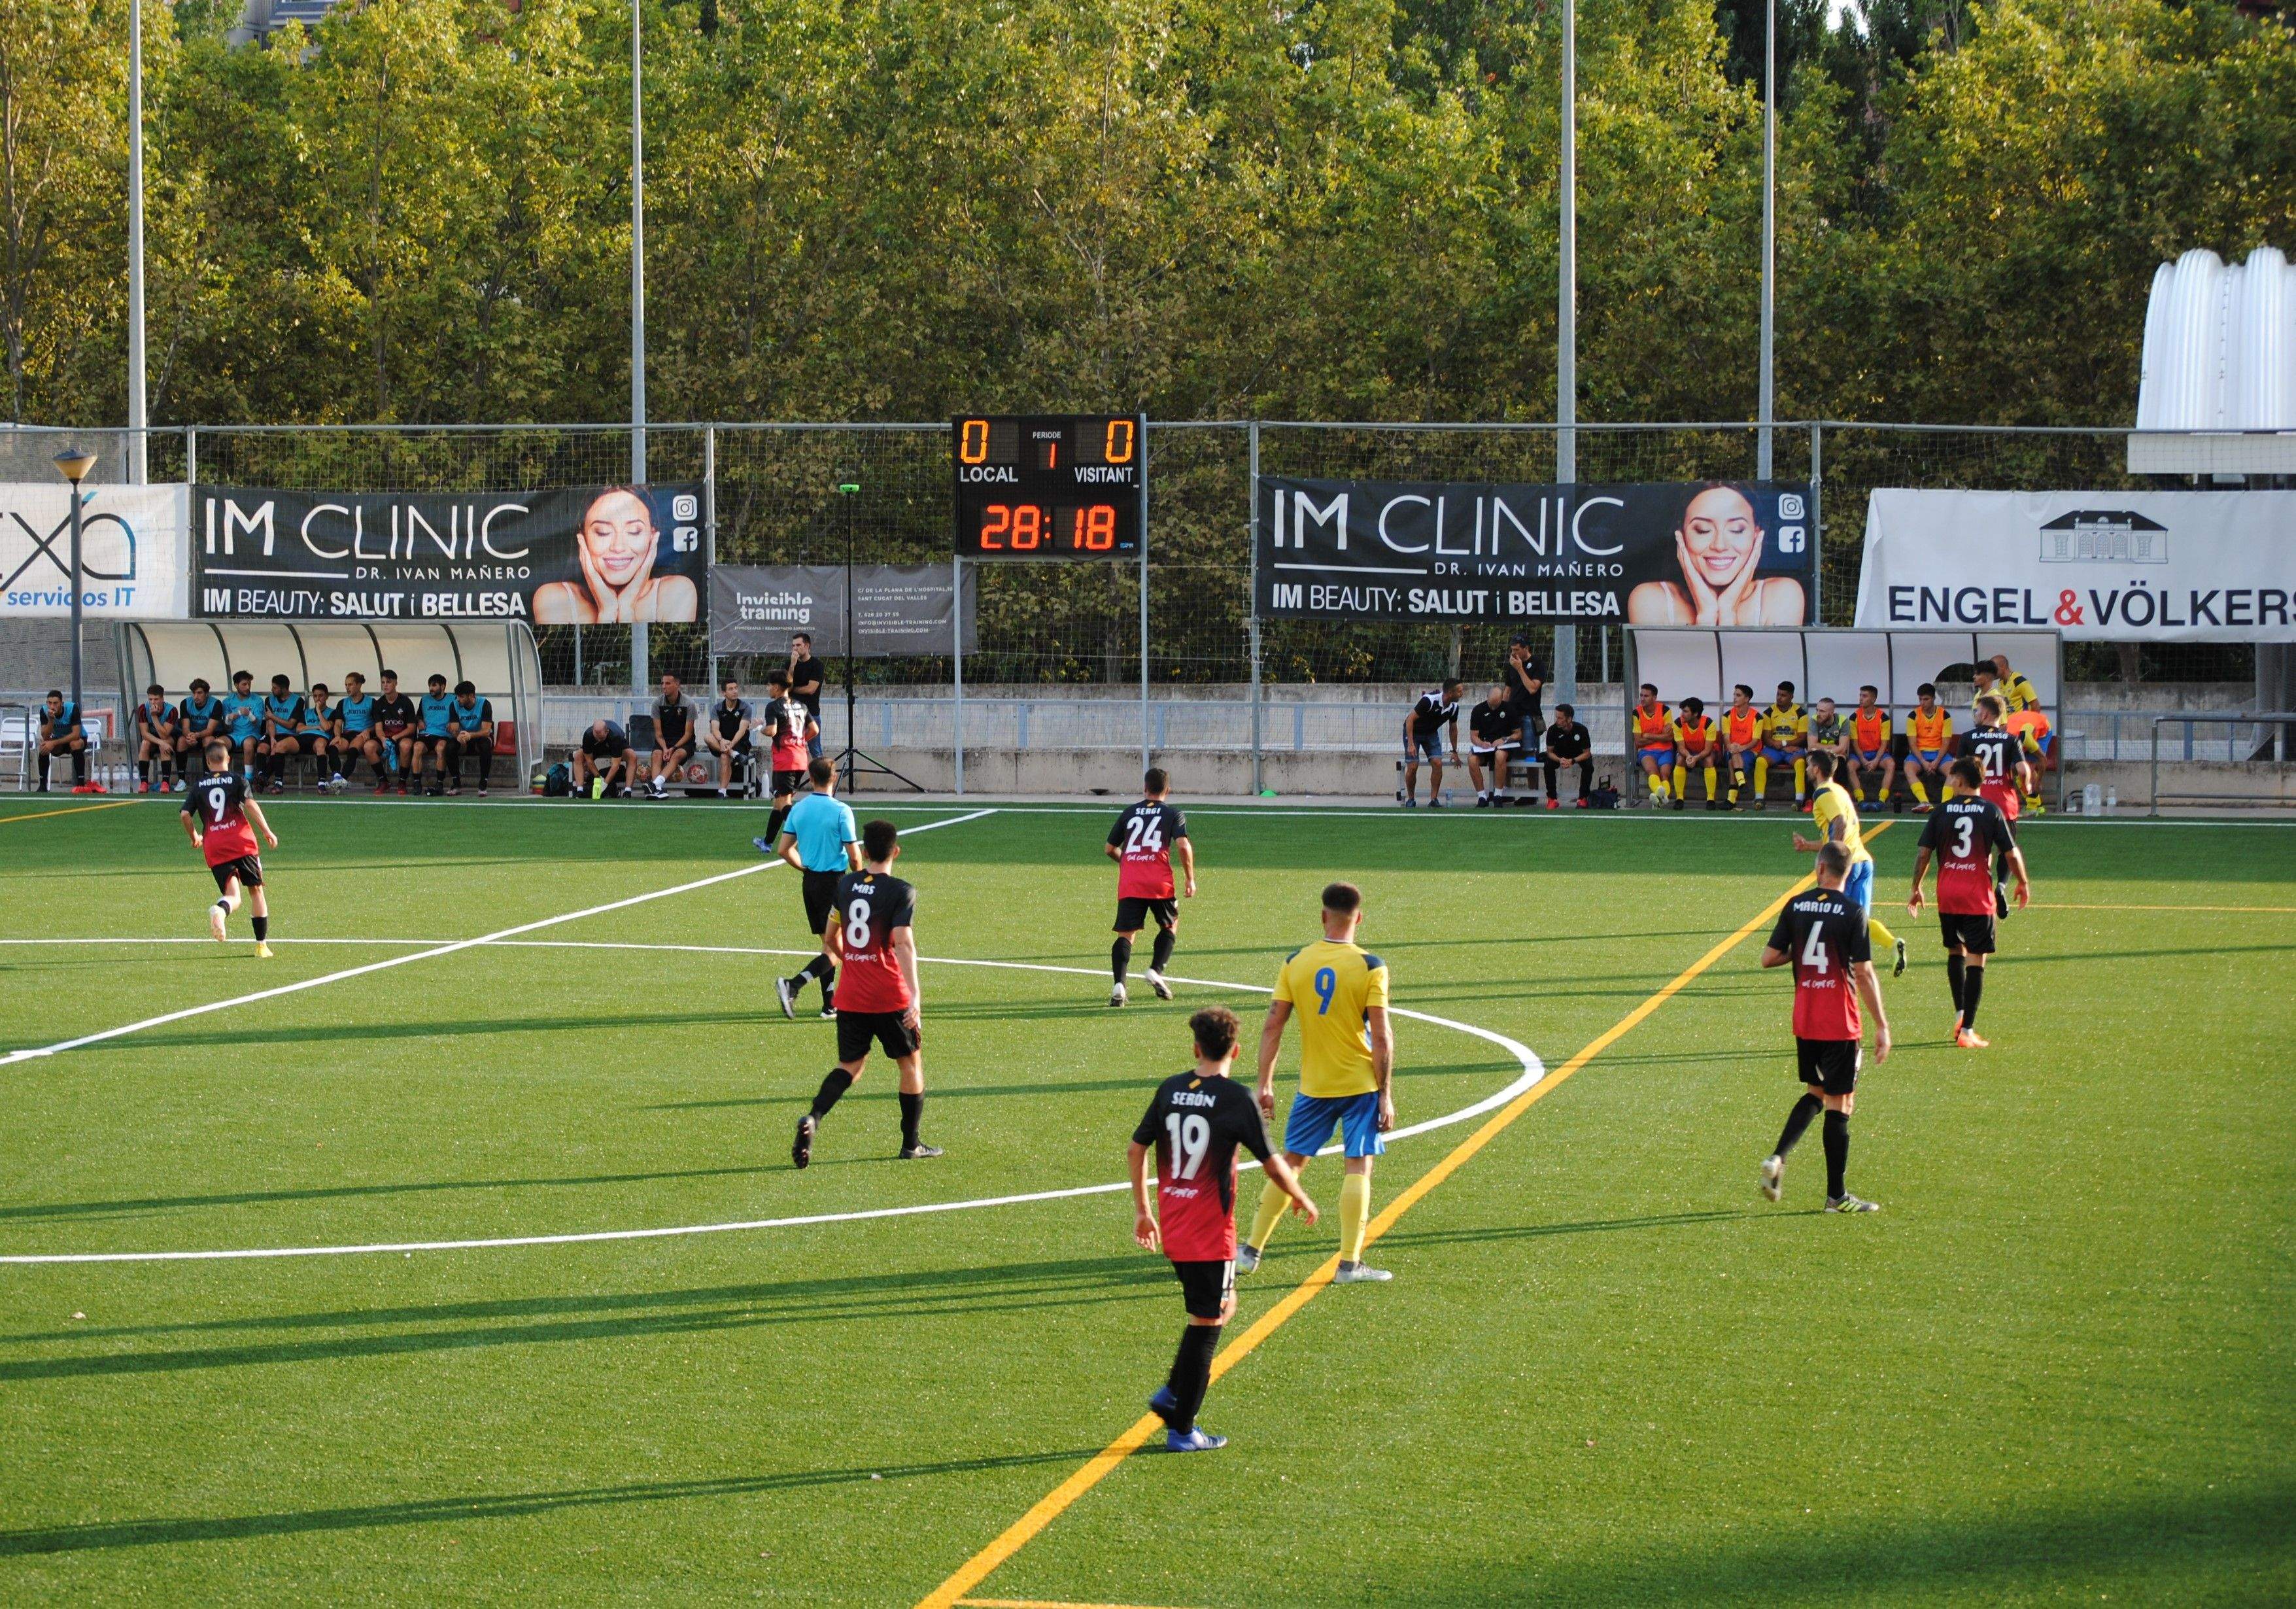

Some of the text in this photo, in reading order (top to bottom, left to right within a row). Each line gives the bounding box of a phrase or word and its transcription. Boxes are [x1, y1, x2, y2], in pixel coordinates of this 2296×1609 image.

[961, 421, 989, 463] 0
[1033, 431, 1061, 440] PERIODE
[1105, 420, 1133, 464] 0
[960, 466, 1018, 482] LOCAL
[1074, 466, 1133, 483] VISITANT
[205, 498, 529, 560] IM CLINIC
[981, 504, 1116, 550] 28:18
[1275, 489, 1624, 556] IM CLINIC
[356, 565, 530, 580] DR. IVAN MAÑERO
[1435, 561, 1624, 577] DR. IVAN MAÑERO
[7, 586, 136, 606] servicos IT
[204, 589, 230, 612] IM
[238, 589, 324, 614] BEAUTY:
[330, 592, 404, 616] SALUT
[422, 592, 526, 616] BELLESA
[736, 592, 813, 605] Invisible
[1273, 583, 1302, 609] IM
[1311, 585, 1402, 613] BEAUTY:
[1409, 589, 1488, 614] SALUT
[1509, 591, 1620, 616] BELLESA
[1889, 581, 2296, 627] ENGEL&VÖLKER
[740, 605, 810, 624] training
[1975, 743, 2003, 777] 21
[198, 776, 233, 787] MORENO
[209, 787, 226, 822] 9
[1125, 816, 1162, 854] 24
[1951, 816, 1973, 858] 3
[851, 882, 876, 895] MAS
[846, 899, 870, 948] 8
[1793, 901, 1832, 913] MARIO
[1802, 921, 1828, 974] 4
[1314, 967, 1335, 1015] 9
[1171, 1090, 1216, 1108] SERÓN
[1165, 1112, 1210, 1180] 19
